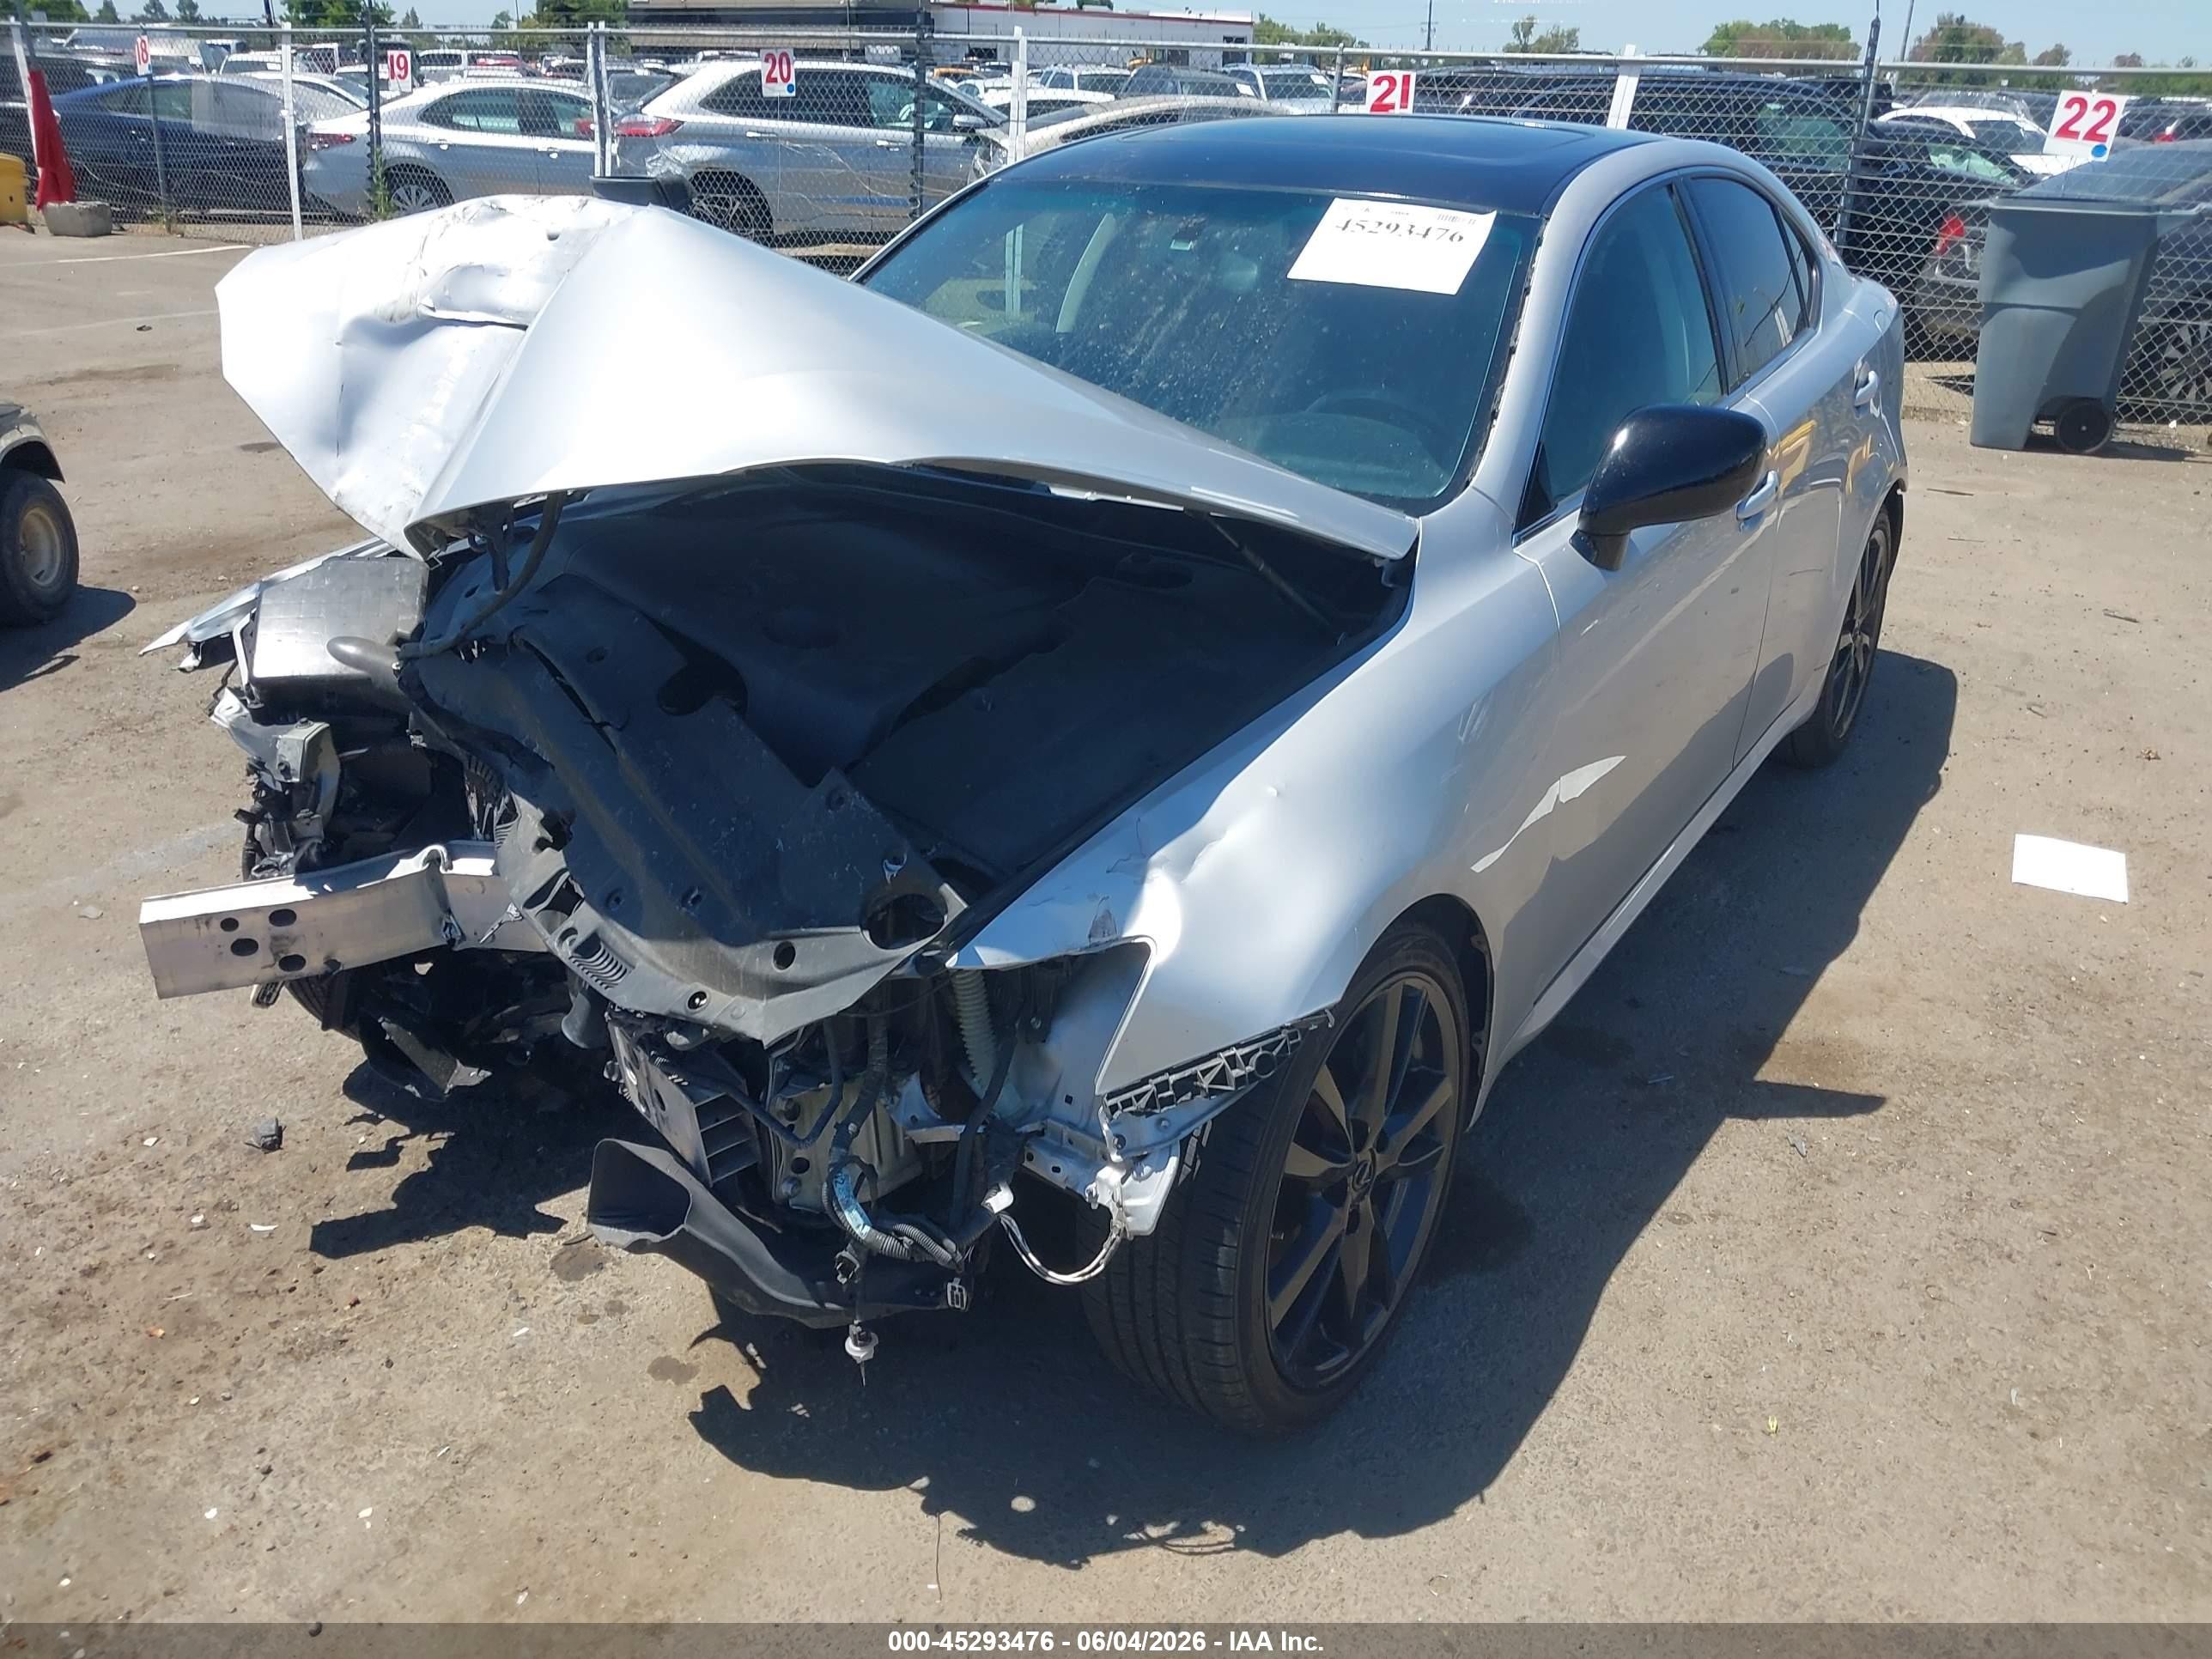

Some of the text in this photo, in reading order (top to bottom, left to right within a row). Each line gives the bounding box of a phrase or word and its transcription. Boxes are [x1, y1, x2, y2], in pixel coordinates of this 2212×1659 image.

[137, 40, 149, 65] 18
[389, 53, 409, 80] 19
[763, 52, 792, 83] 20
[1370, 74, 1411, 112] 21
[2053, 96, 2117, 143] 22
[1335, 218, 1464, 243] 45293476
